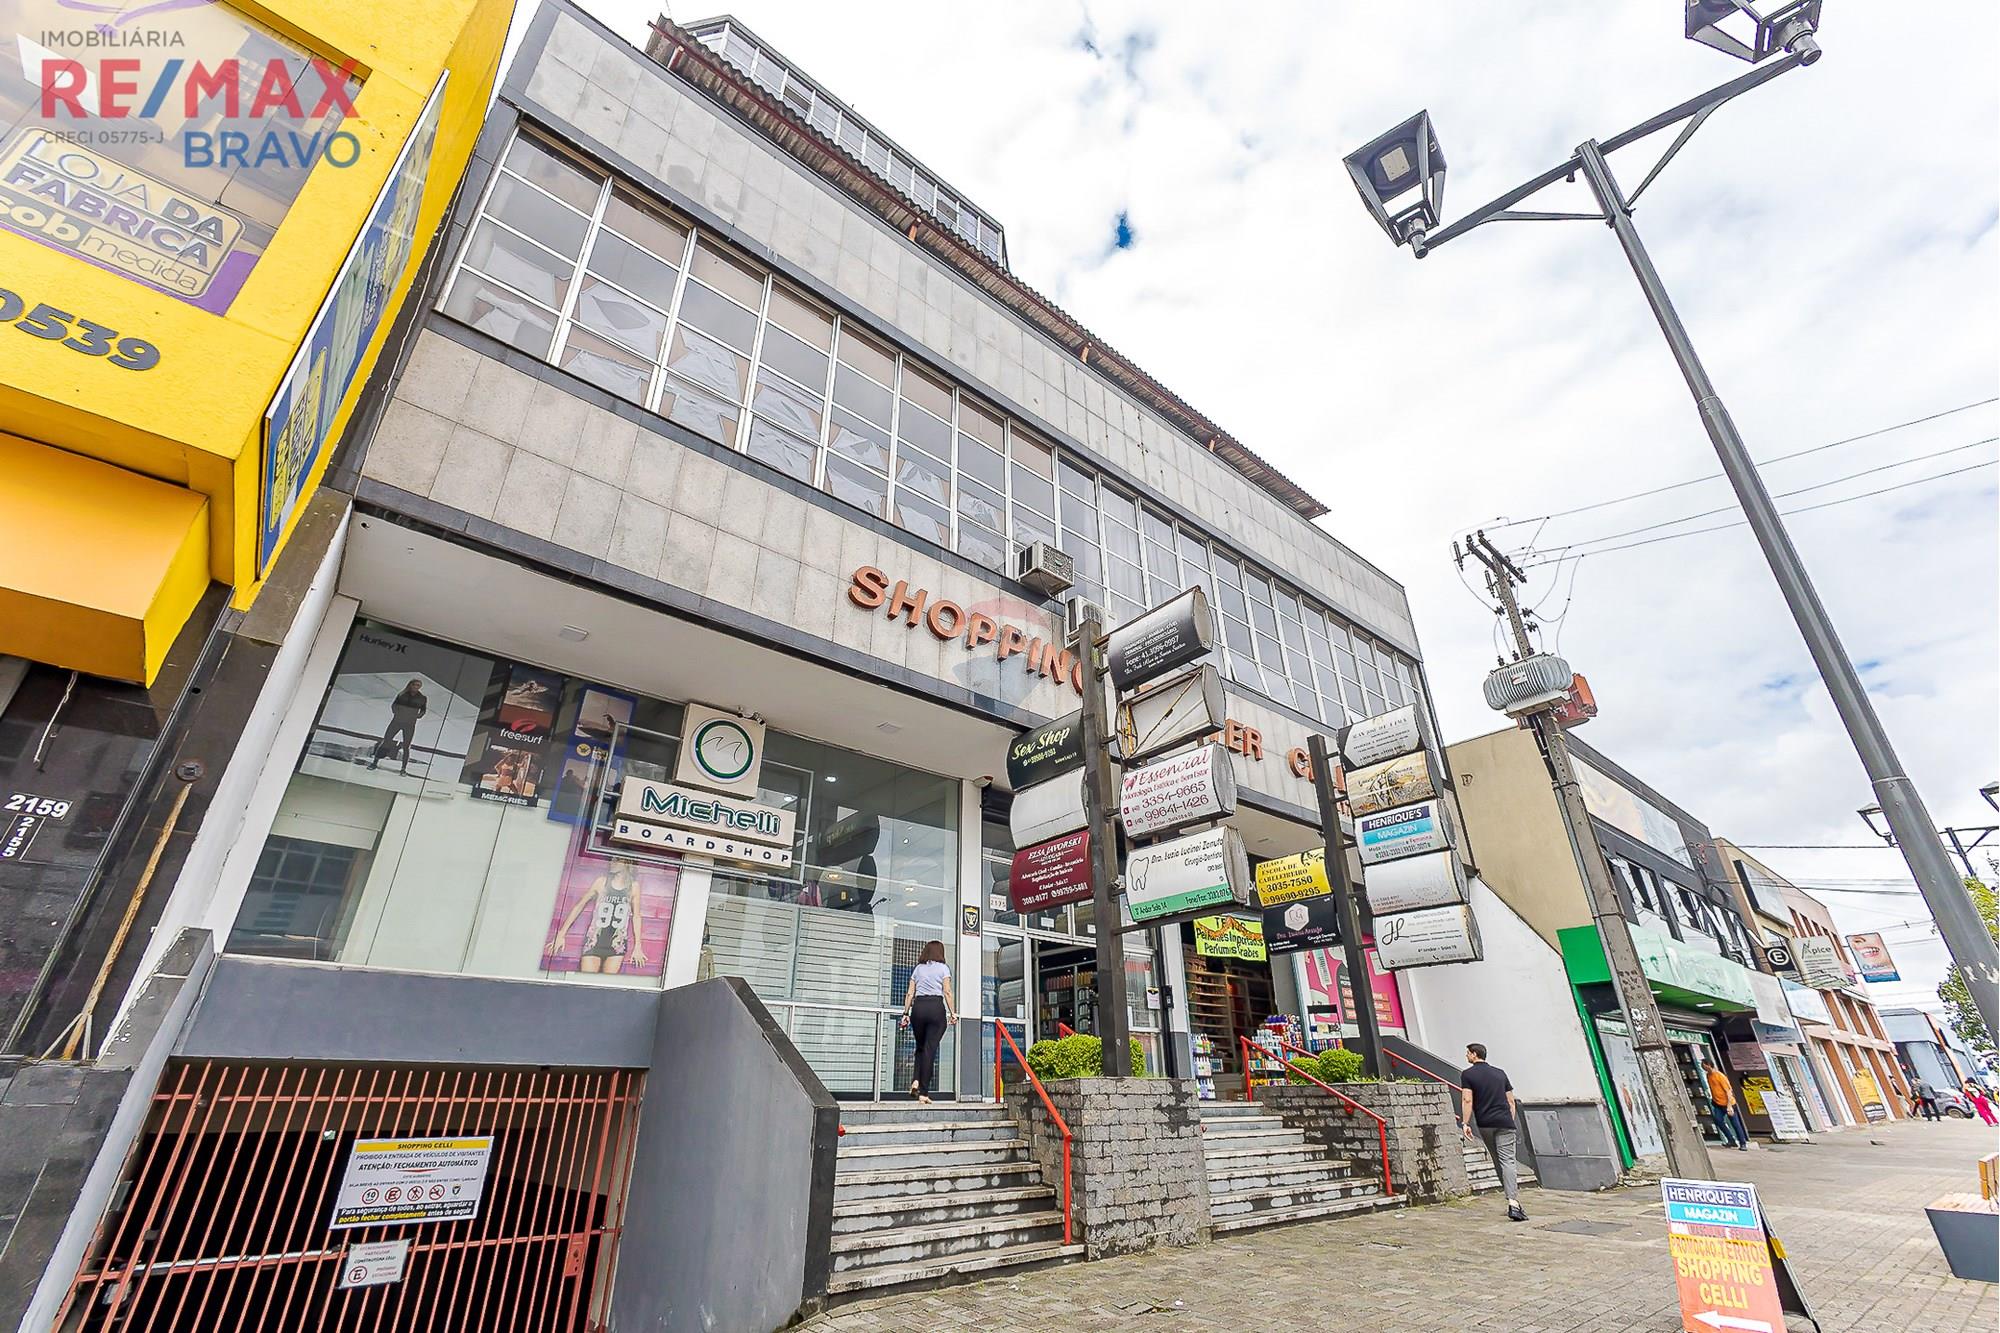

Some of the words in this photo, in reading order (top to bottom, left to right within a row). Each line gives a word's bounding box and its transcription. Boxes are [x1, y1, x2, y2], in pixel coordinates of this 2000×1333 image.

[24, 136, 149, 211] LOJA
[161, 197, 224, 242] DA
[4, 162, 208, 267] FABRICA
[83, 231, 198, 291] medida
[359, 633, 393, 650] Hurley
[500, 728, 543, 744] freesurf
[1011, 741, 1036, 760] Sex
[1037, 727, 1071, 750] Shop
[1138, 748, 1210, 785] Essencial
[4, 794, 70, 818] 2159
[1142, 780, 1207, 809] 3384-9665
[641, 786, 781, 835] Michelli
[1145, 794, 1209, 822] 99641-1426
[1369, 808, 1423, 829] HENRIQUE'S
[2, 817, 35, 857] 2155
[619, 823, 790, 863] BOARDSHOP
[1377, 824, 1418, 840] MAGAZIN
[1267, 875, 1313, 892] 3035-7580
[1269, 887, 1321, 903] 99690-9295
[358, 1161, 392, 1172] ATENÇÃO:
[394, 1161, 437, 1169] FECHAMENTO
[438, 1159, 478, 1168] AUTOMÁTICO
[341, 1207, 355, 1215] Para
[356, 1206, 387, 1215] segurança
[443, 1200, 467, 1209] aguardar
[1669, 1186, 1749, 1206] HENRIQUE'S
[339, 1215, 359, 1223] portão
[360, 1213, 380, 1221] fechar
[381, 1210, 426, 1220] completamente
[453, 1208, 472, 1216] seguir
[1684, 1207, 1739, 1222] MAGAZIN
[1677, 1256, 1764, 1287] SHOPPING
[1699, 1282, 1749, 1309] CELLI
